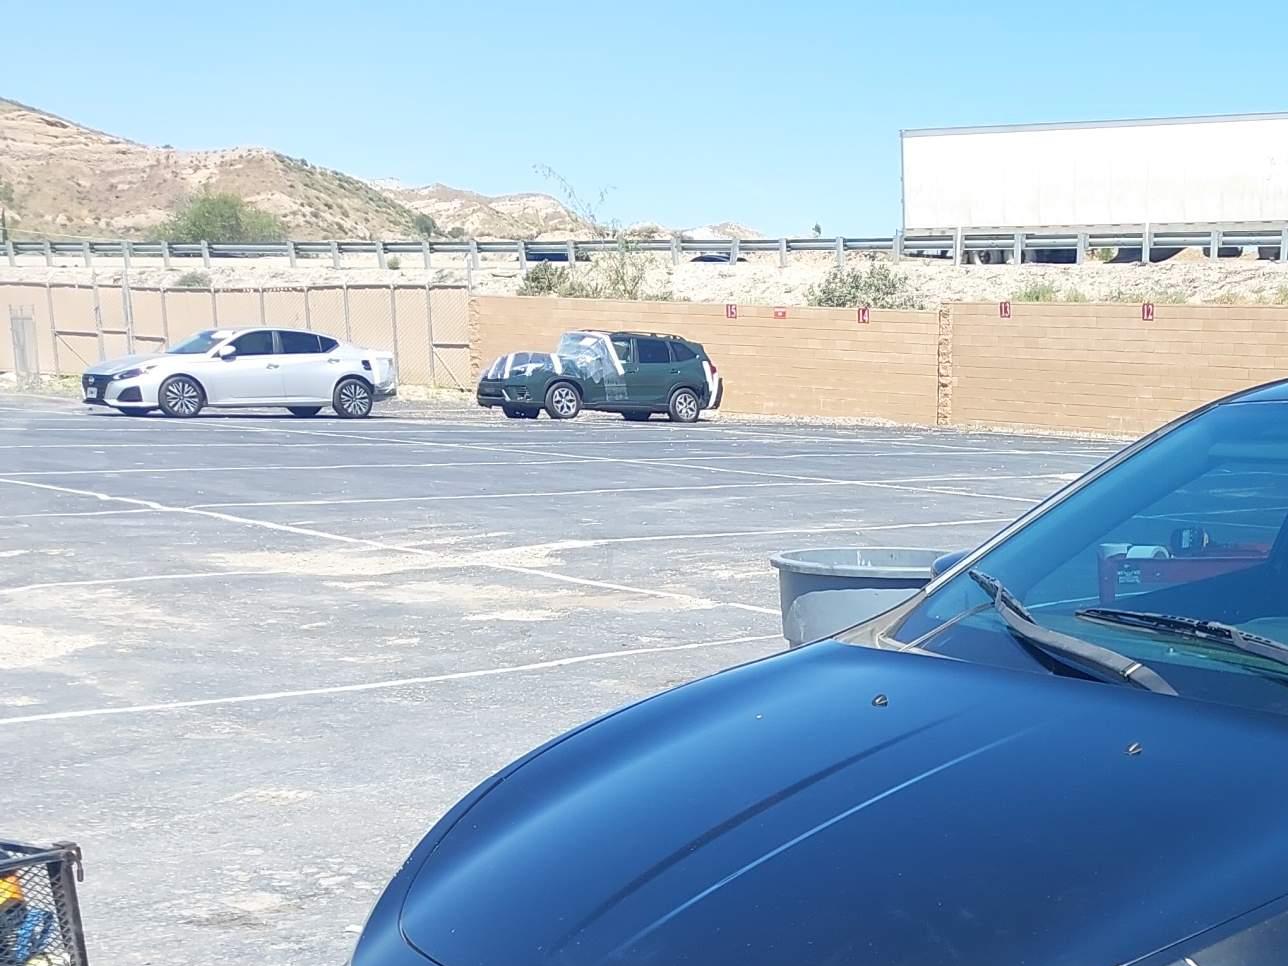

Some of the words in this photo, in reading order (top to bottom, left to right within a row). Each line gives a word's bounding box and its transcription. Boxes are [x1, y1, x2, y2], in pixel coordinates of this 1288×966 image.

[726, 304, 737, 318] 15
[858, 308, 869, 323] 14
[1143, 303, 1154, 320] 12
